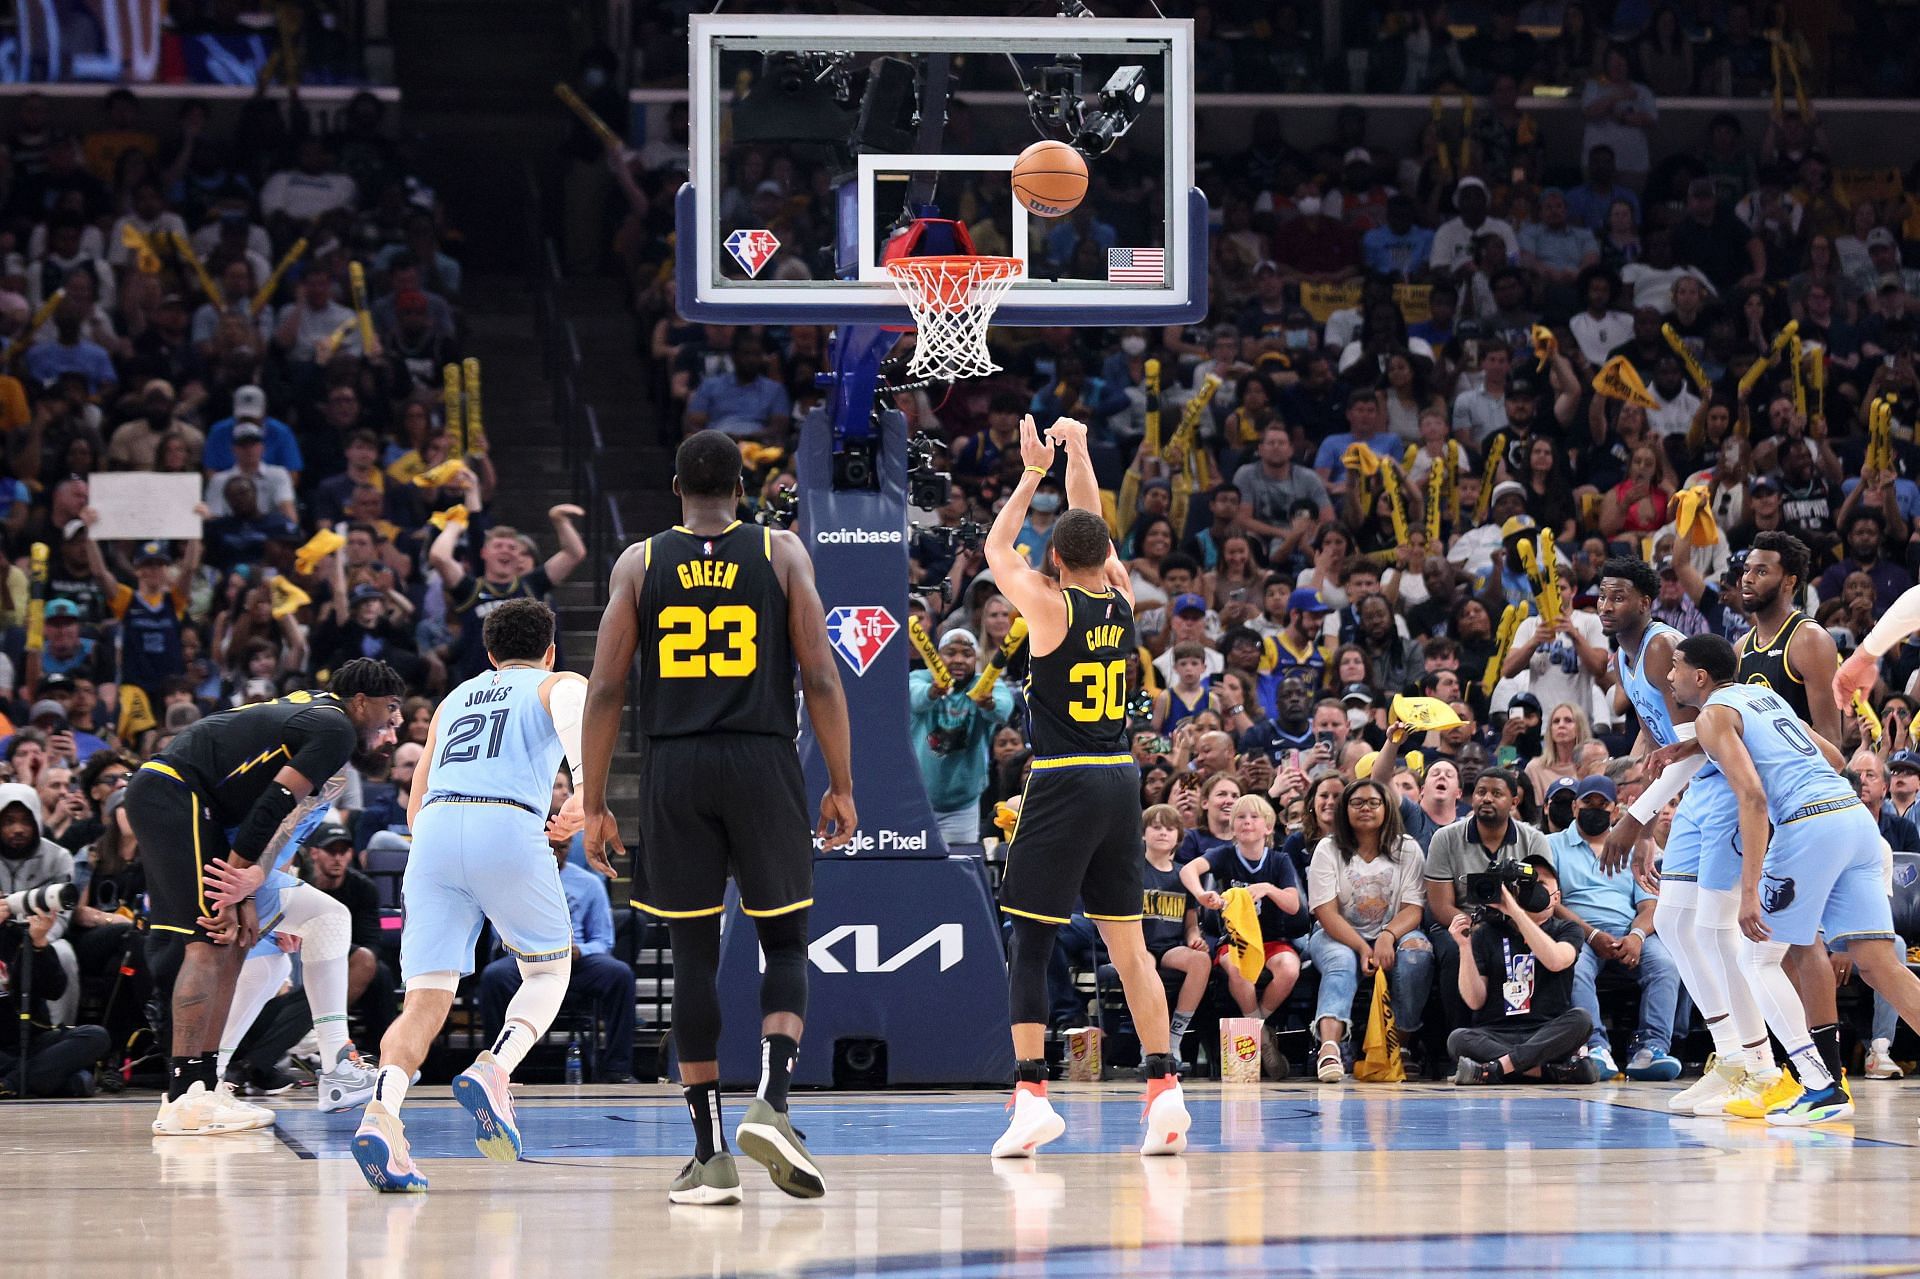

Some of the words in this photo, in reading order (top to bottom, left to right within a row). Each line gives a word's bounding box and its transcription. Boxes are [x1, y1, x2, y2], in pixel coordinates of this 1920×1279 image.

[817, 527, 902, 544] coinbase
[676, 560, 739, 590] GREEN
[865, 616, 882, 637] 75
[1085, 624, 1125, 651] CURRY
[658, 605, 757, 679] 23
[464, 686, 513, 708] JONES
[1069, 658, 1127, 722] 30
[439, 708, 510, 769] 21
[1773, 717, 1818, 757] 0
[878, 829, 927, 850] Pixel
